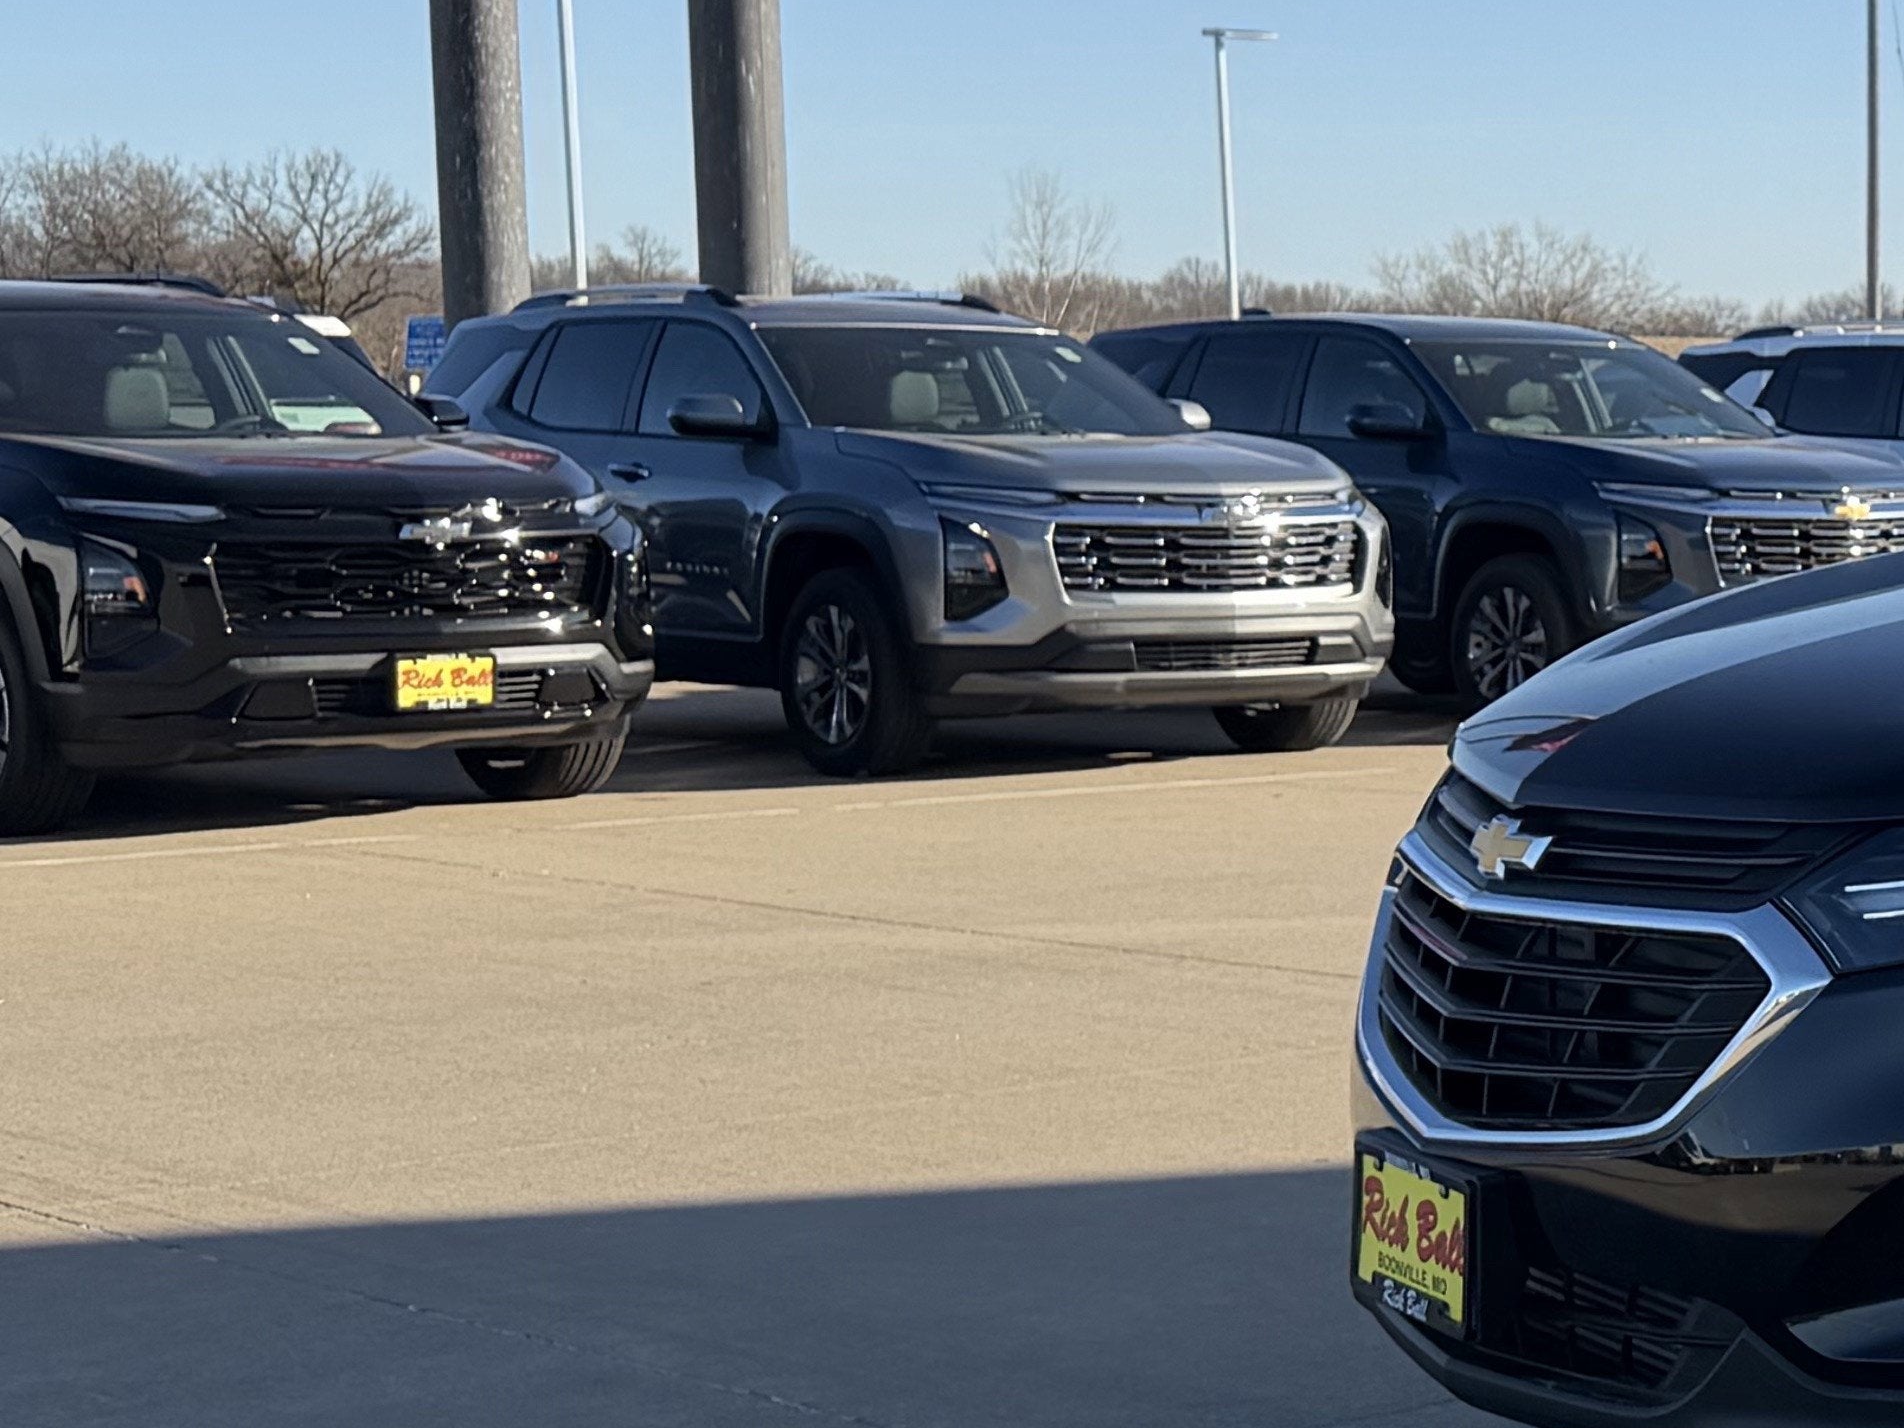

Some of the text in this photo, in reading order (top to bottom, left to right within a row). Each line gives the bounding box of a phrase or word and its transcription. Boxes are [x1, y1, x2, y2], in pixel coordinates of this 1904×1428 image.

[400, 668, 444, 690] Rick
[1363, 1175, 1465, 1278] Rick Ball
